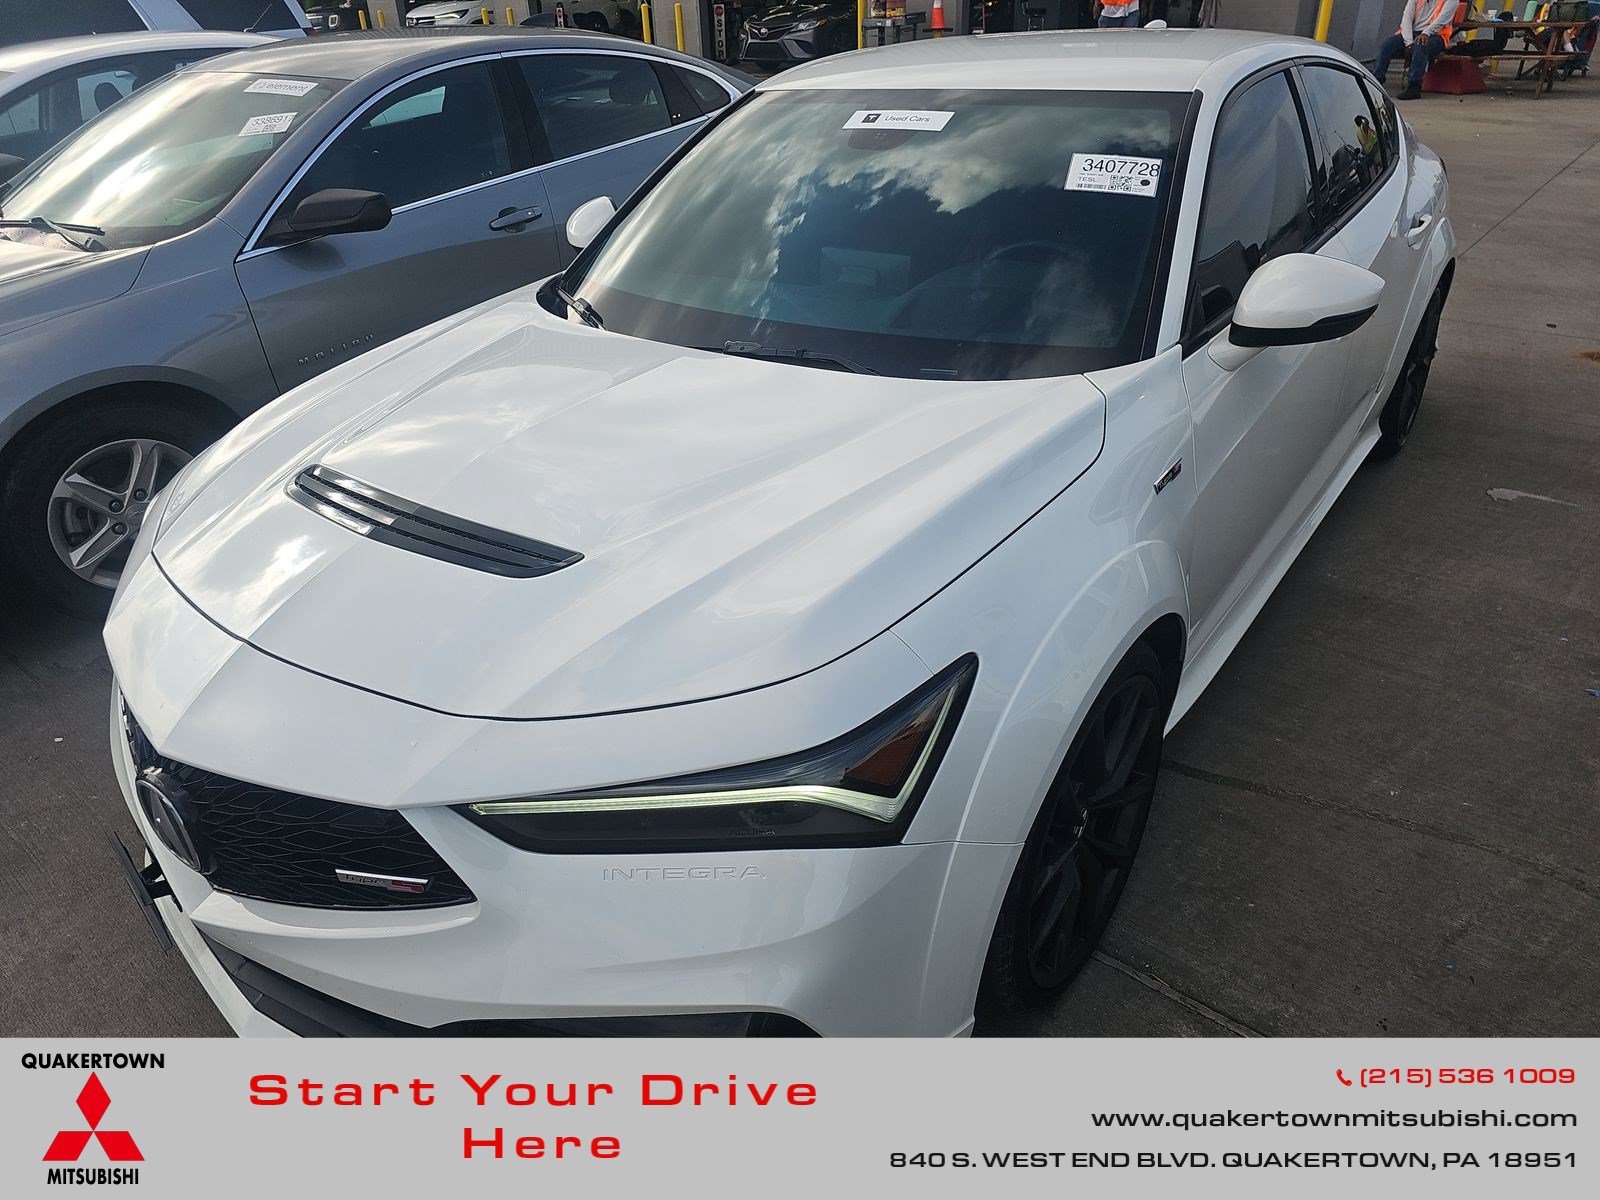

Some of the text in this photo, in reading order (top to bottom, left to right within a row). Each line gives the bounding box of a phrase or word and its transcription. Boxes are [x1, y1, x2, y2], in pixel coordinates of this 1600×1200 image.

[716, 18, 725, 59] STOP
[265, 83, 309, 92] element
[1082, 158, 1161, 178] 3407728
[603, 865, 767, 881] INTEGRA
